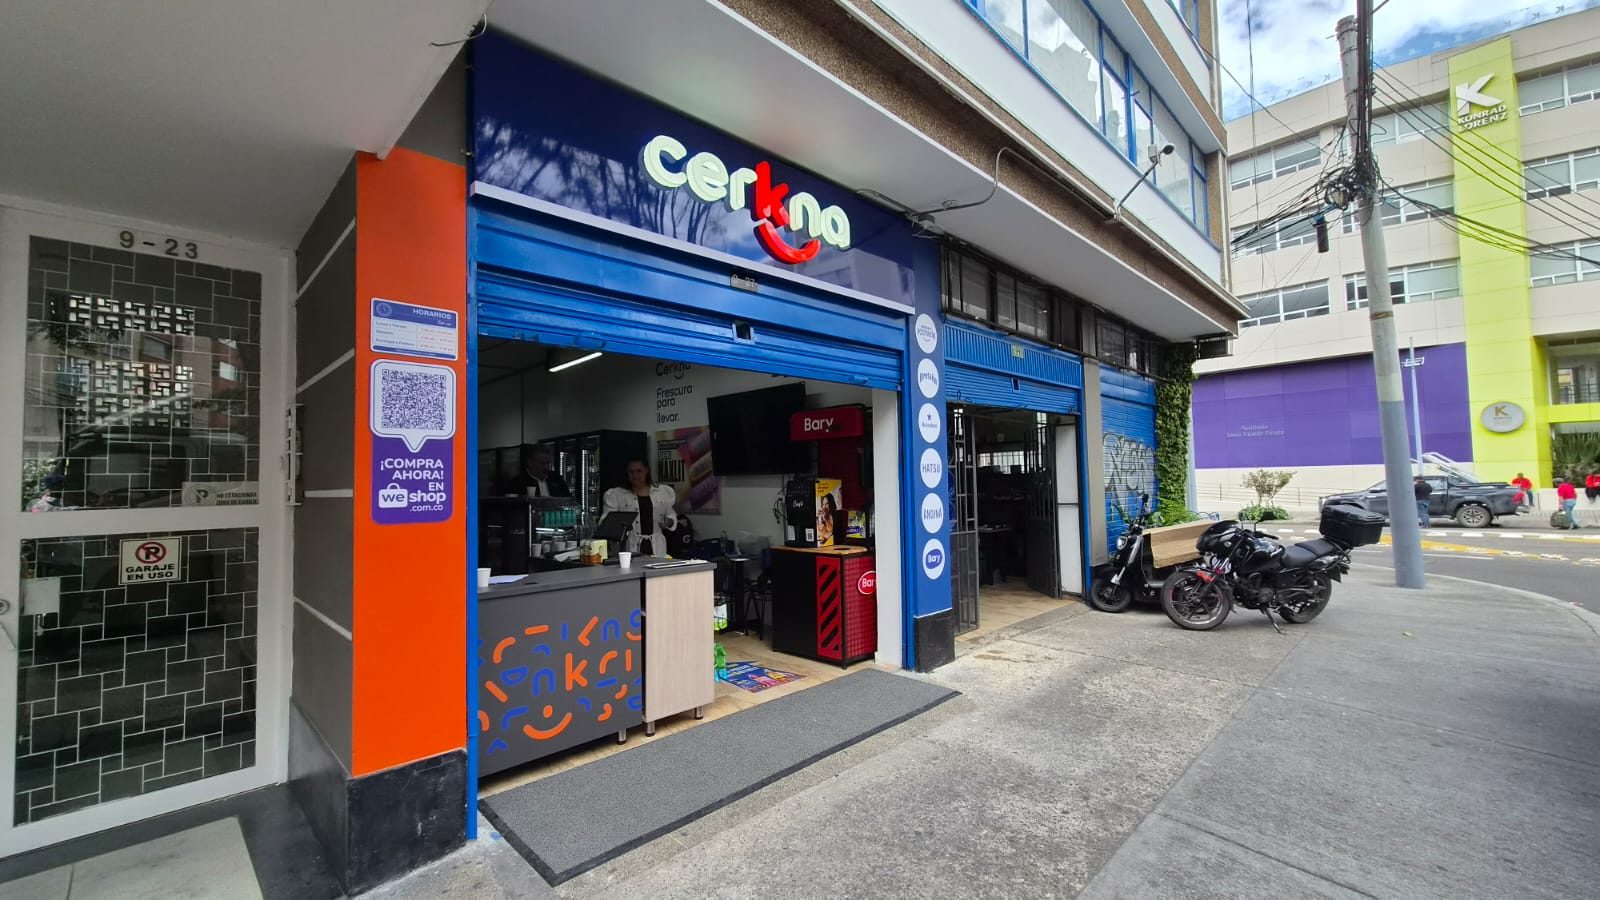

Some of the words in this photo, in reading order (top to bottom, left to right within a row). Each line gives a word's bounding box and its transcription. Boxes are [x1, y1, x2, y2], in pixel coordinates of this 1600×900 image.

[1458, 104, 1507, 124] KONRAD
[1458, 111, 1508, 132] LORENZ
[640, 134, 851, 265] cerkna
[412, 308, 452, 320] HORARIOS
[656, 385, 693, 399] Frescura
[656, 398, 676, 411] para
[380, 457, 444, 471] ¡COMPRA
[922, 463, 941, 473] HATSU
[391, 469, 444, 480] AHORA!
[428, 481, 444, 491] EN
[409, 504, 444, 512] .com.co
[927, 553, 941, 564] Bary
[125, 563, 176, 574] GARAJE
[126, 573, 144, 581] EN
[148, 571, 174, 580] USO
